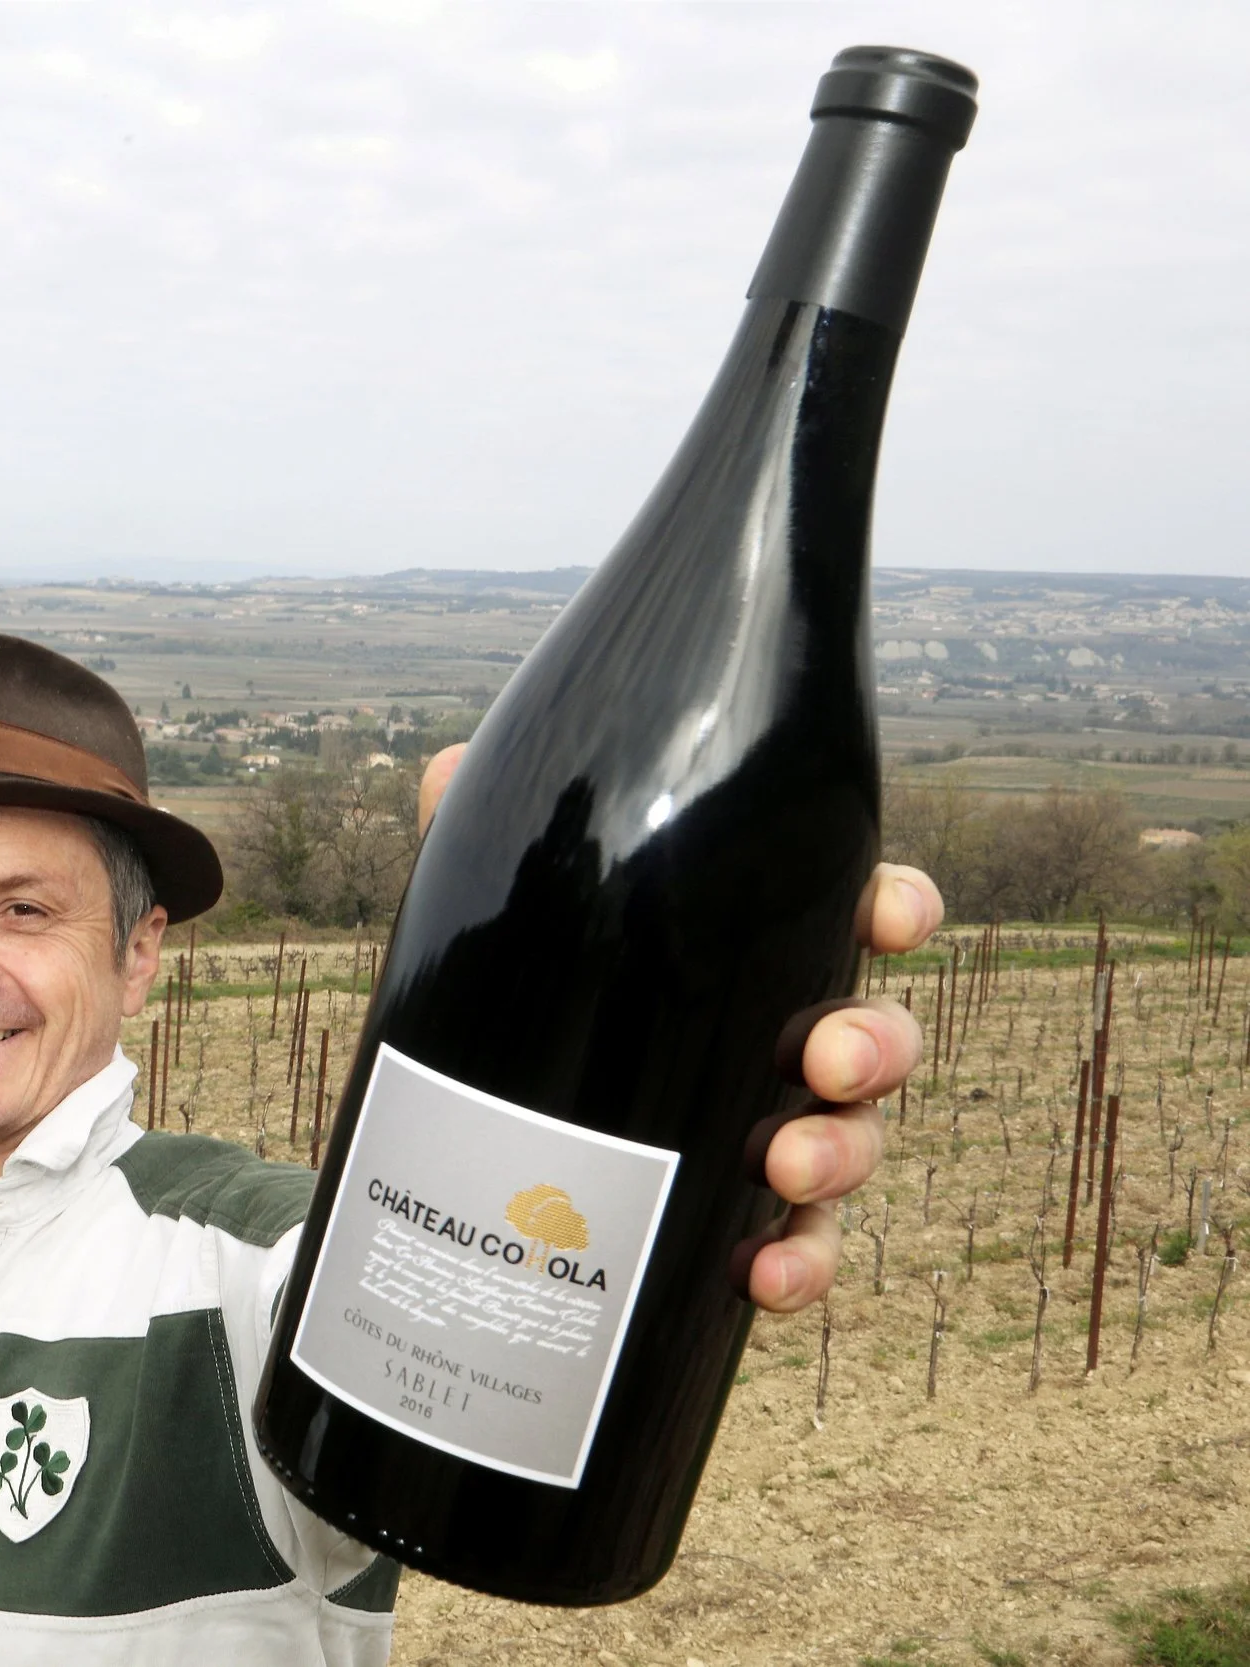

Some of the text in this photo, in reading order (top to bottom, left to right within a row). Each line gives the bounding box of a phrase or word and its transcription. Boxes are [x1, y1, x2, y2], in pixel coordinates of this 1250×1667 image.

[367, 1178, 477, 1247] CHÂTEAU
[343, 1308, 543, 1405] CÔTES DU RHÔNE VILLAGES
[399, 1395, 433, 1419] 2016
